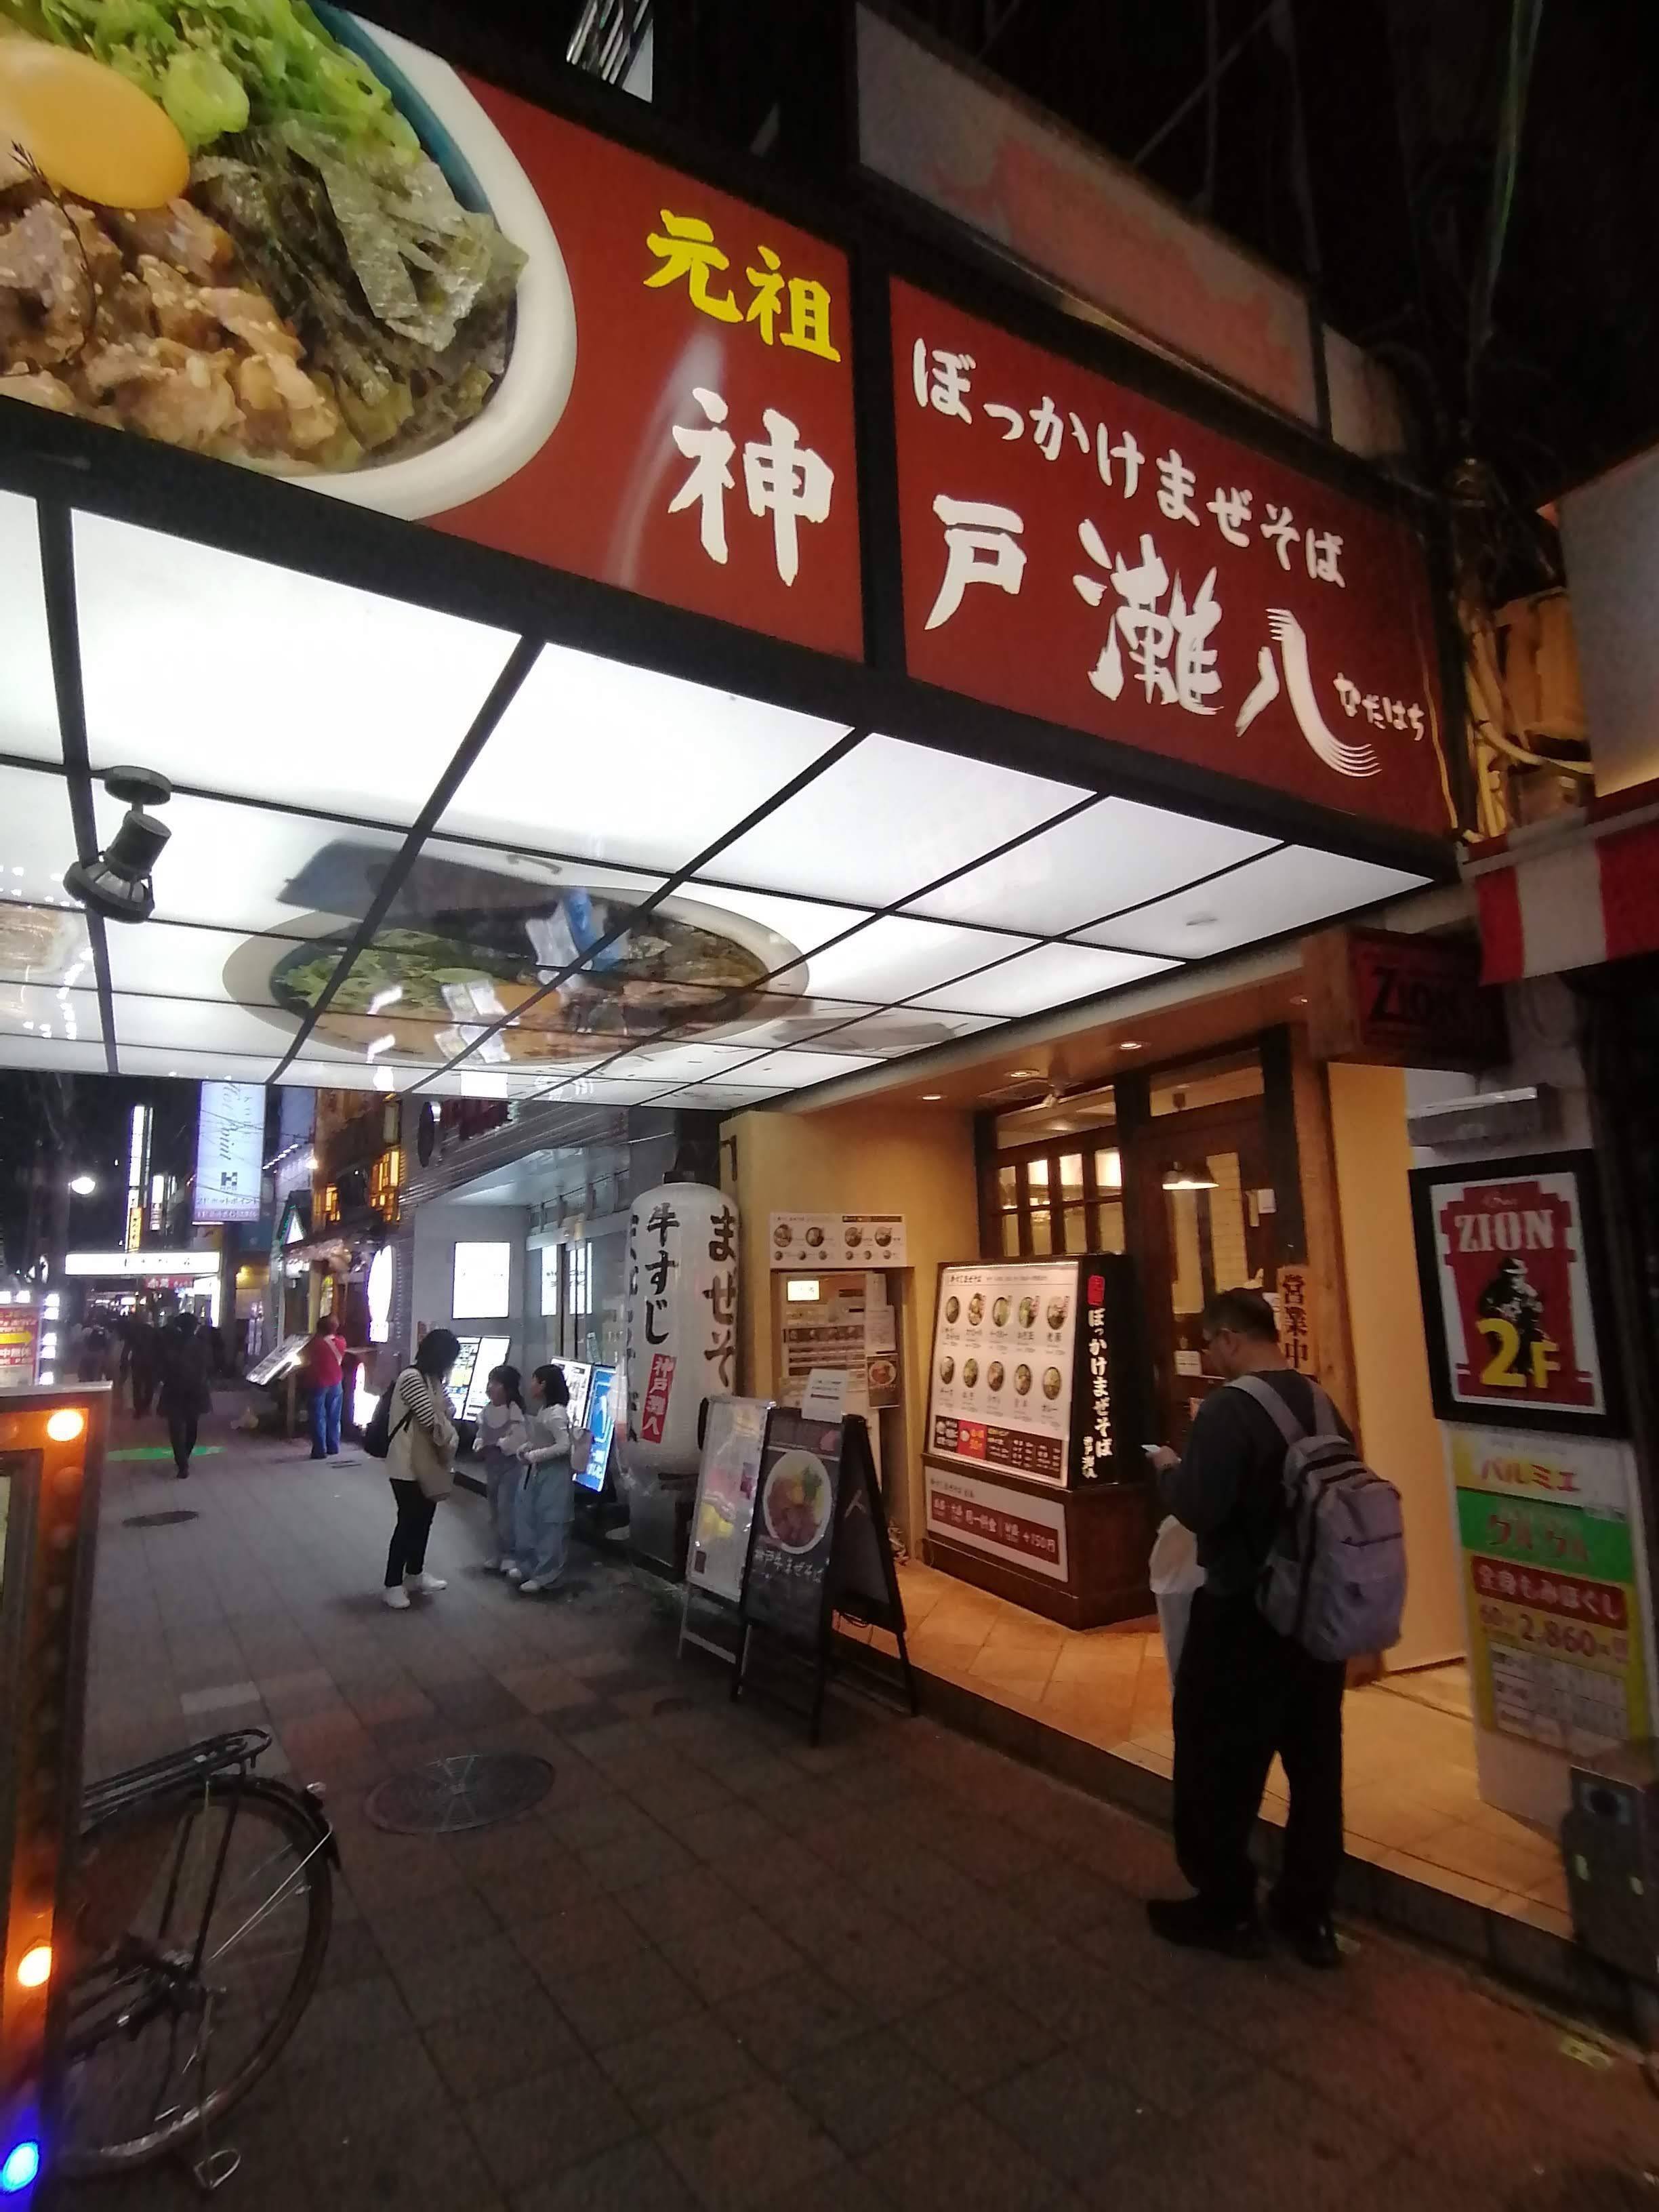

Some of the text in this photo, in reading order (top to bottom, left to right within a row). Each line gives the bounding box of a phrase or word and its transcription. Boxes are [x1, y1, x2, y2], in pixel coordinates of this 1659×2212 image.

[643, 209, 841, 363] 元祖
[913, 337, 1346, 588] ぼっかけまぜそば
[1333, 672, 1425, 741] なだはち
[644, 1202, 680, 1345] 牛すじ
[1454, 1209, 1555, 1252] ZION
[1283, 1274, 1309, 1368] 営業中
[1475, 1317, 1561, 1389] 2F
[1088, 1307, 1113, 1458] ぼっかけまぜそば
[1477, 1563, 1622, 1622] 全身もみほぐし
